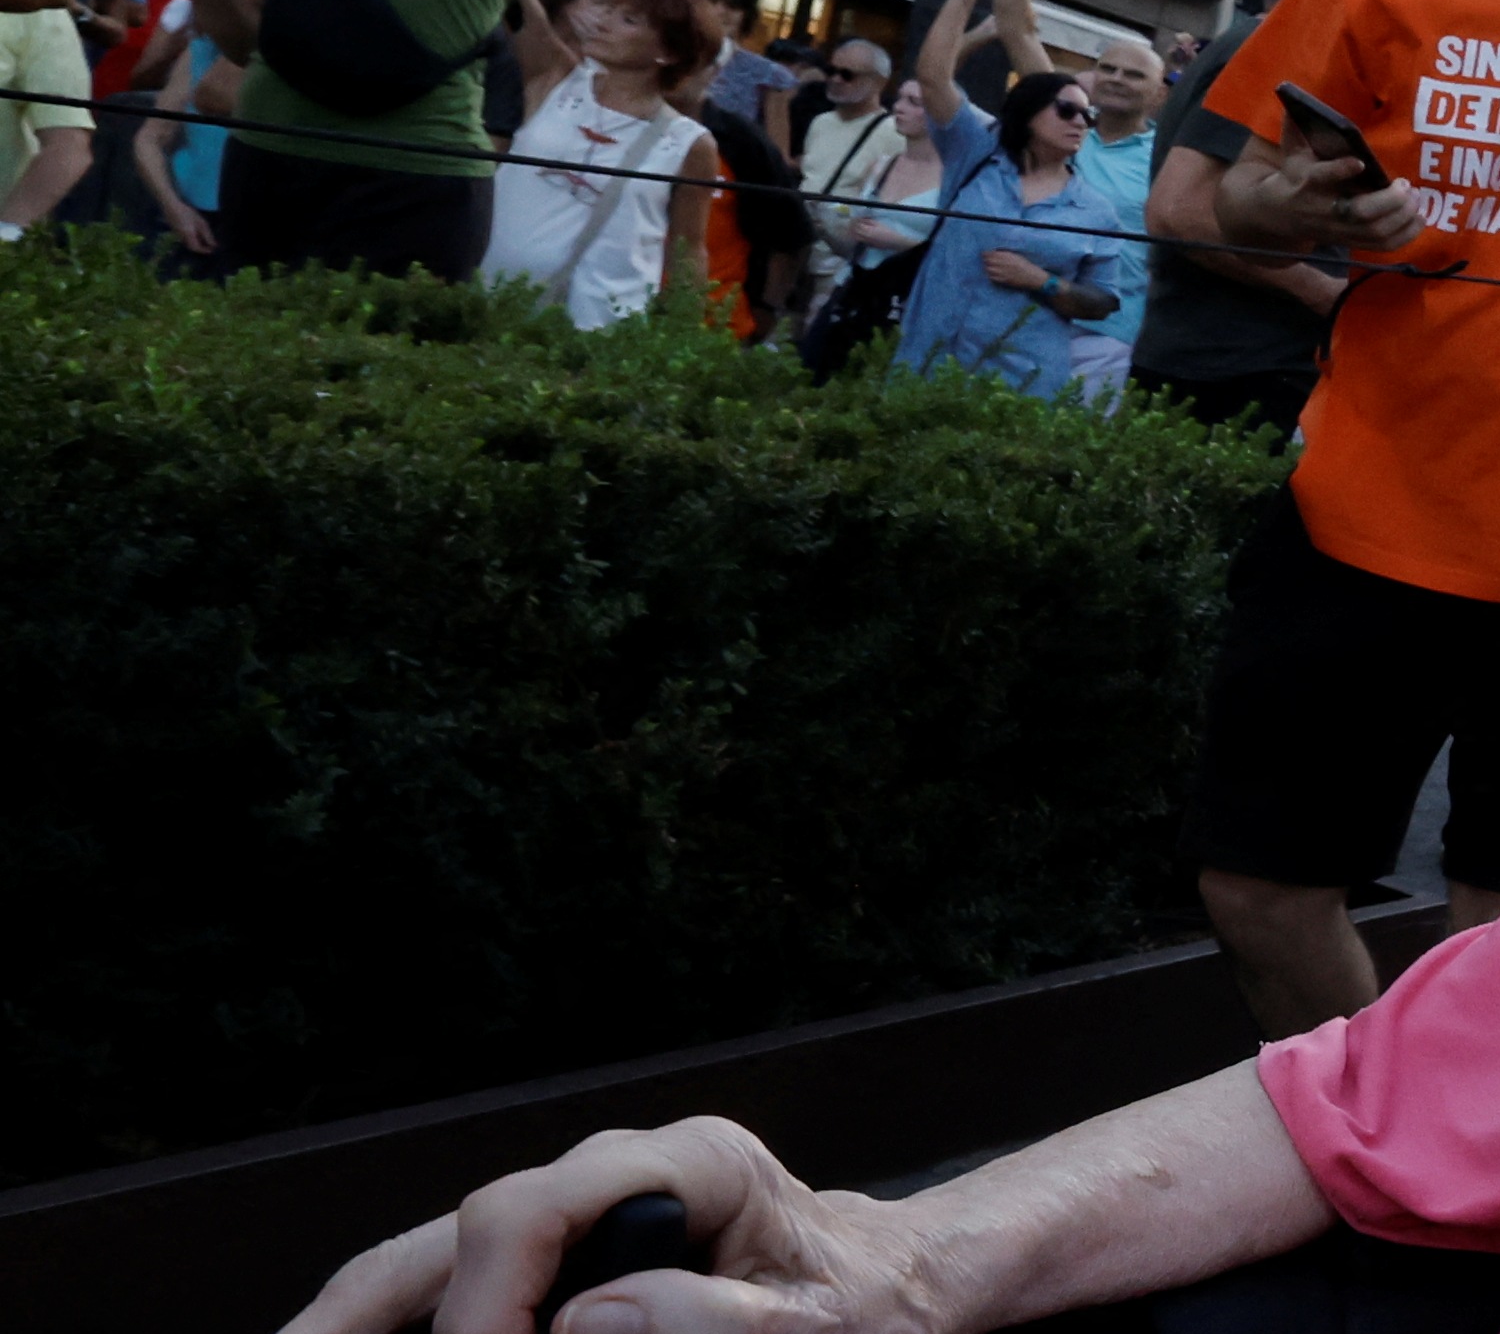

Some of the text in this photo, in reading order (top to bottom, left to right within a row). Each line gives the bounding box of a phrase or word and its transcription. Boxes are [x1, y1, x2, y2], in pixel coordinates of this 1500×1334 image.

[1425, 89, 1482, 131] DE
[1418, 140, 1445, 182] E
[1418, 185, 1466, 234] DE
